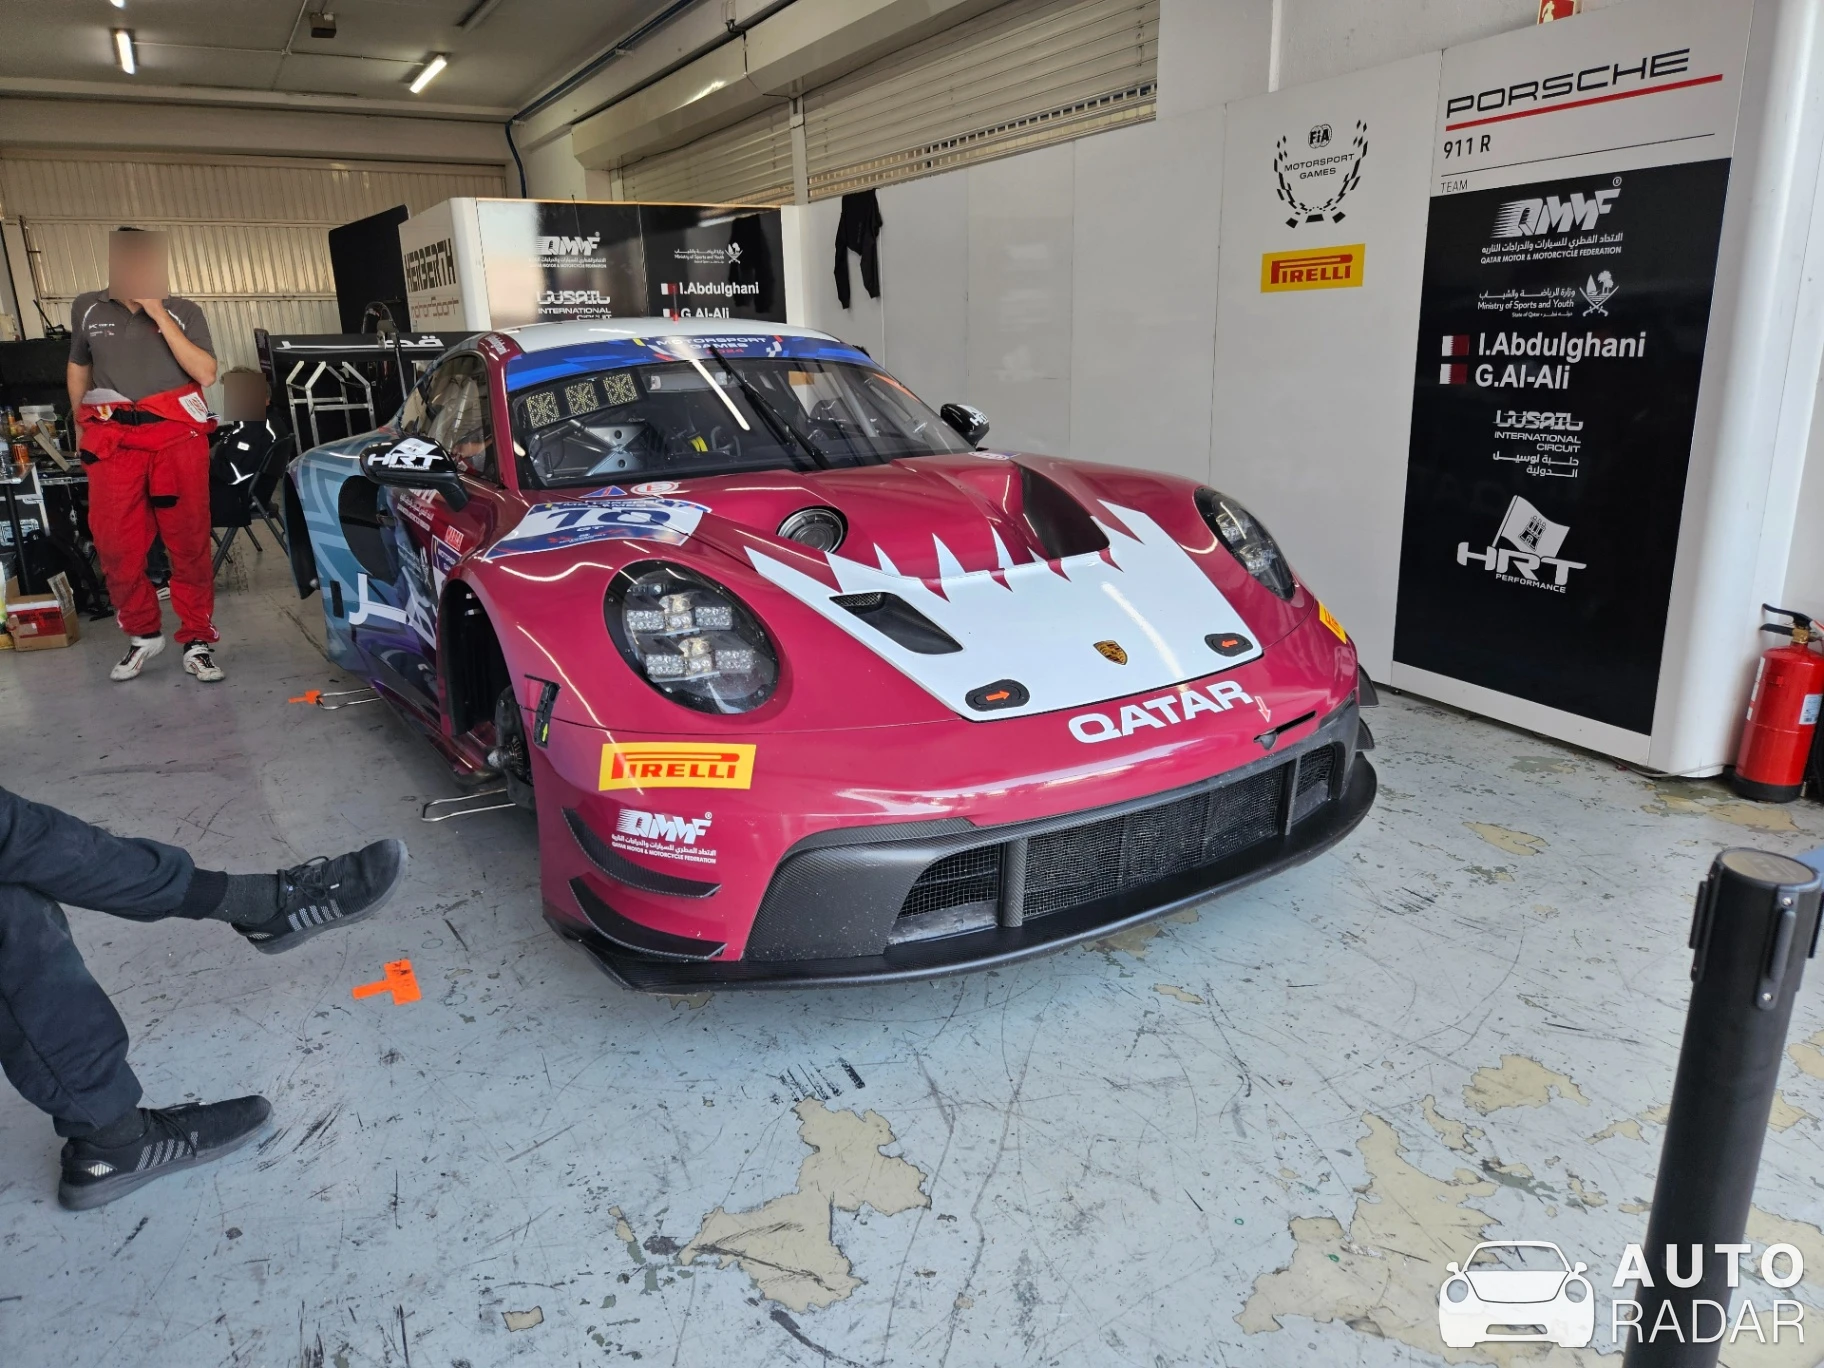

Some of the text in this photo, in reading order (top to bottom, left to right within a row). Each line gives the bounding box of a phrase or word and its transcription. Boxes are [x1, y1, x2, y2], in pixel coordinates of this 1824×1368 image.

[1446, 48, 1690, 119] PORSCHE
[1443, 134, 1491, 159] 911 R
[1284, 153, 1354, 172] MOTORSPORT
[1300, 168, 1336, 180] GAMES
[1440, 180, 1468, 194] TEAM
[1534, 238, 1568, 250] للسيارات
[1568, 234, 1598, 249] القطري
[1480, 256, 1501, 264] QATAR
[1502, 253, 1526, 263] MOTOR
[1532, 250, 1578, 260] MOTORCYCLE
[1580, 246, 1622, 256] FEDERATION
[404, 238, 456, 293] HERBERTH
[1270, 254, 1353, 284] PIRELLI
[680, 282, 759, 297] I.Abdulghani
[1478, 298, 1574, 312] Ministry of Sports and Youth
[656, 337, 766, 346] MOTORSPORT
[1478, 332, 1646, 363] I.Abdulghani
[1475, 364, 1570, 390] G.Al-Ali
[1494, 431, 1581, 444] INTERNATIONAL
[1536, 444, 1580, 453] CIRCUIT
[367, 452, 444, 467] HRT
[1456, 542, 1587, 586] HRT
[1496, 573, 1566, 593] PERFORMANCE
[1068, 680, 1254, 744] QATAR
[611, 752, 740, 780] PIRELLI
